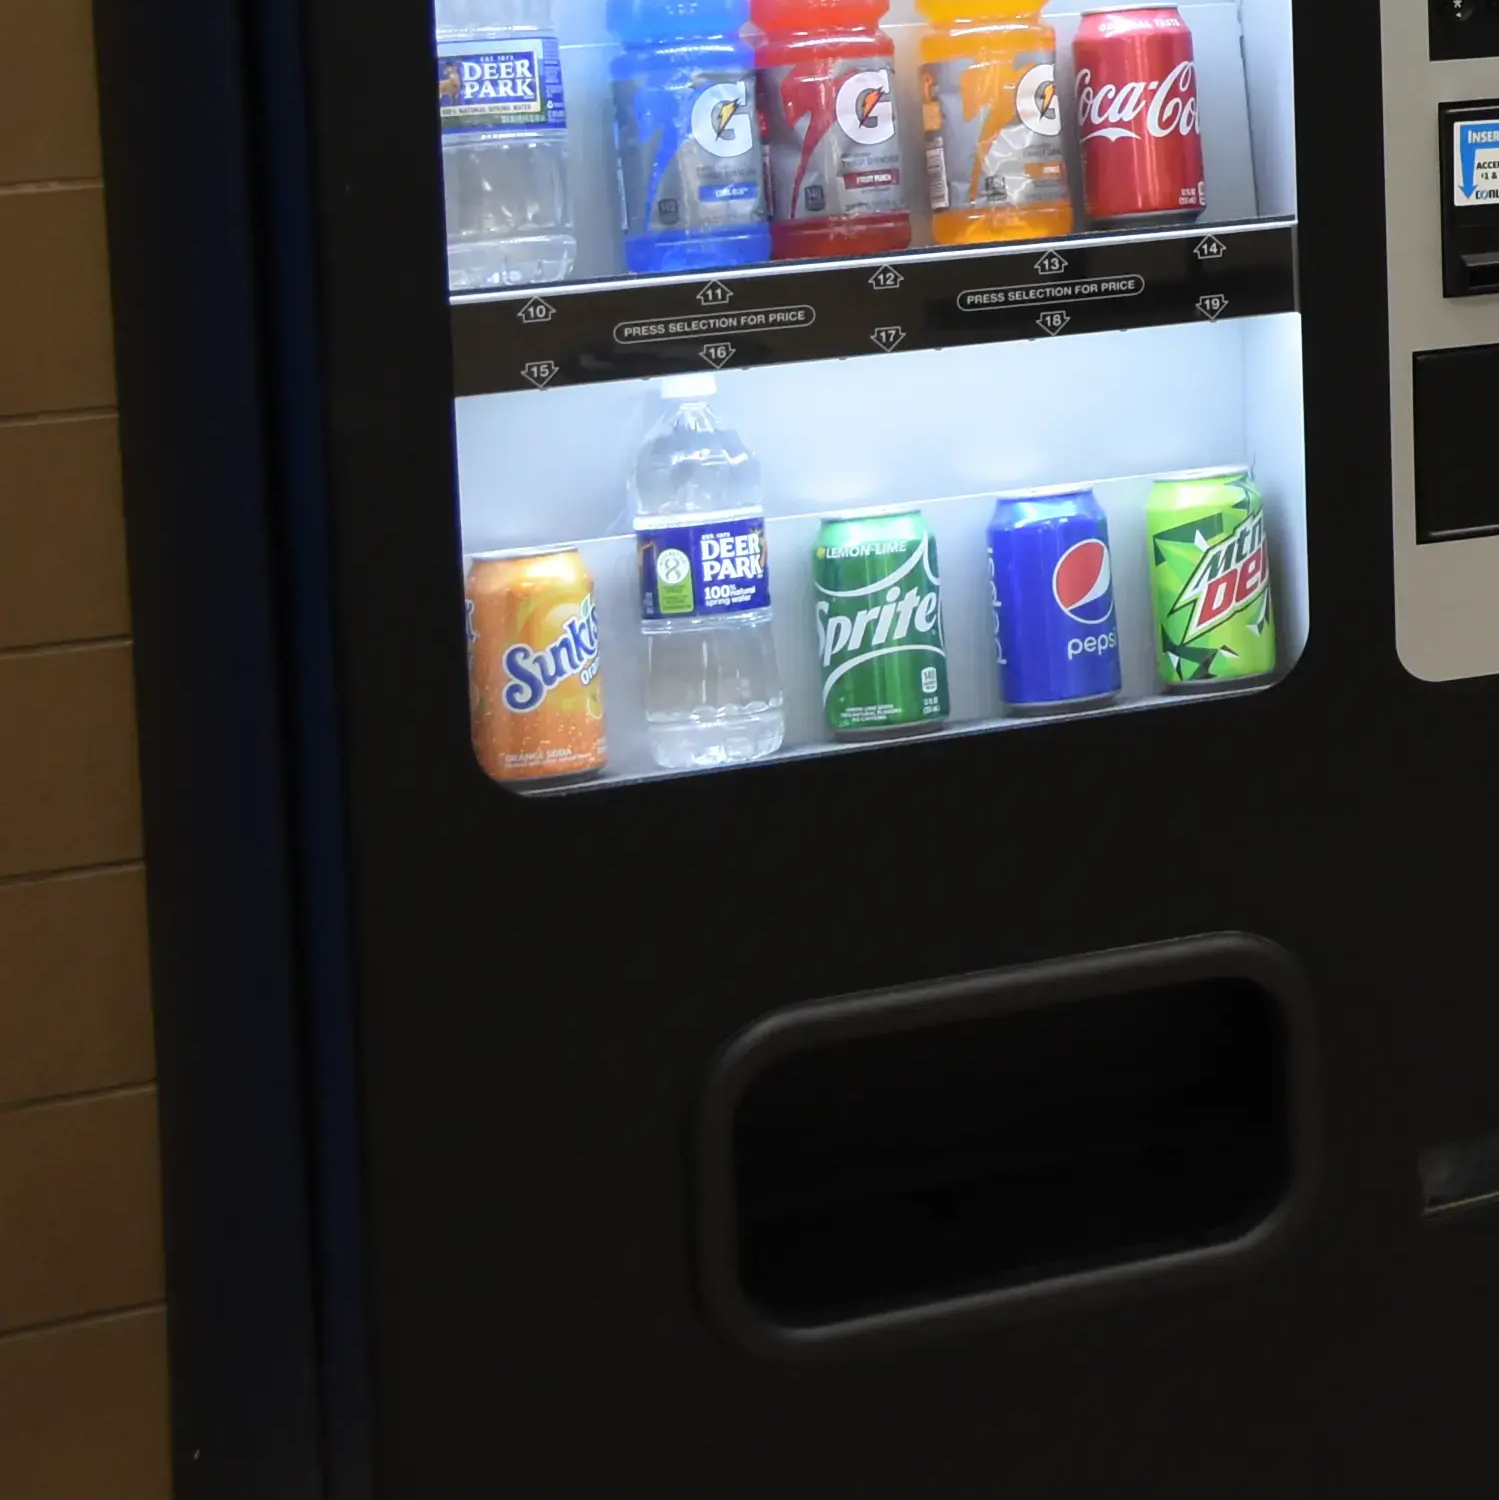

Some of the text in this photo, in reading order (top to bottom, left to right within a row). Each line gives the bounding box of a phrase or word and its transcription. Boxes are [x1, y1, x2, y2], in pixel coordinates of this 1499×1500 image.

[461, 58, 533, 81] DEER
[463, 78, 535, 99] PARK
[836, 69, 896, 145] G
[1016, 63, 1062, 137] G
[691, 80, 753, 158] G
[855, 173, 892, 186] FRUIT PUNCH
[1201, 243, 1218, 255] 14
[1042, 257, 1060, 271] 13
[877, 272, 895, 286] 12
[706, 288, 722, 300] 11
[966, 279, 1136, 306] PRESS SELECTION FOR PRICE
[528, 305, 546, 318] 10
[1203, 298, 1221, 311] 19
[624, 310, 806, 338] PRESS SELECTION FOR PRICE
[1044, 314, 1062, 327] 18
[880, 330, 896, 343] 17
[708, 346, 727, 359] 16
[531, 365, 549, 378] 15
[700, 533, 761, 561] DEER
[826, 540, 908, 559] LEMON-LIME
[702, 554, 763, 582] PARK
[704, 583, 737, 600] 100%
[816, 586, 938, 668] Sprite
[505, 752, 546, 763] ORANGE
[546, 748, 572, 759] SODA
